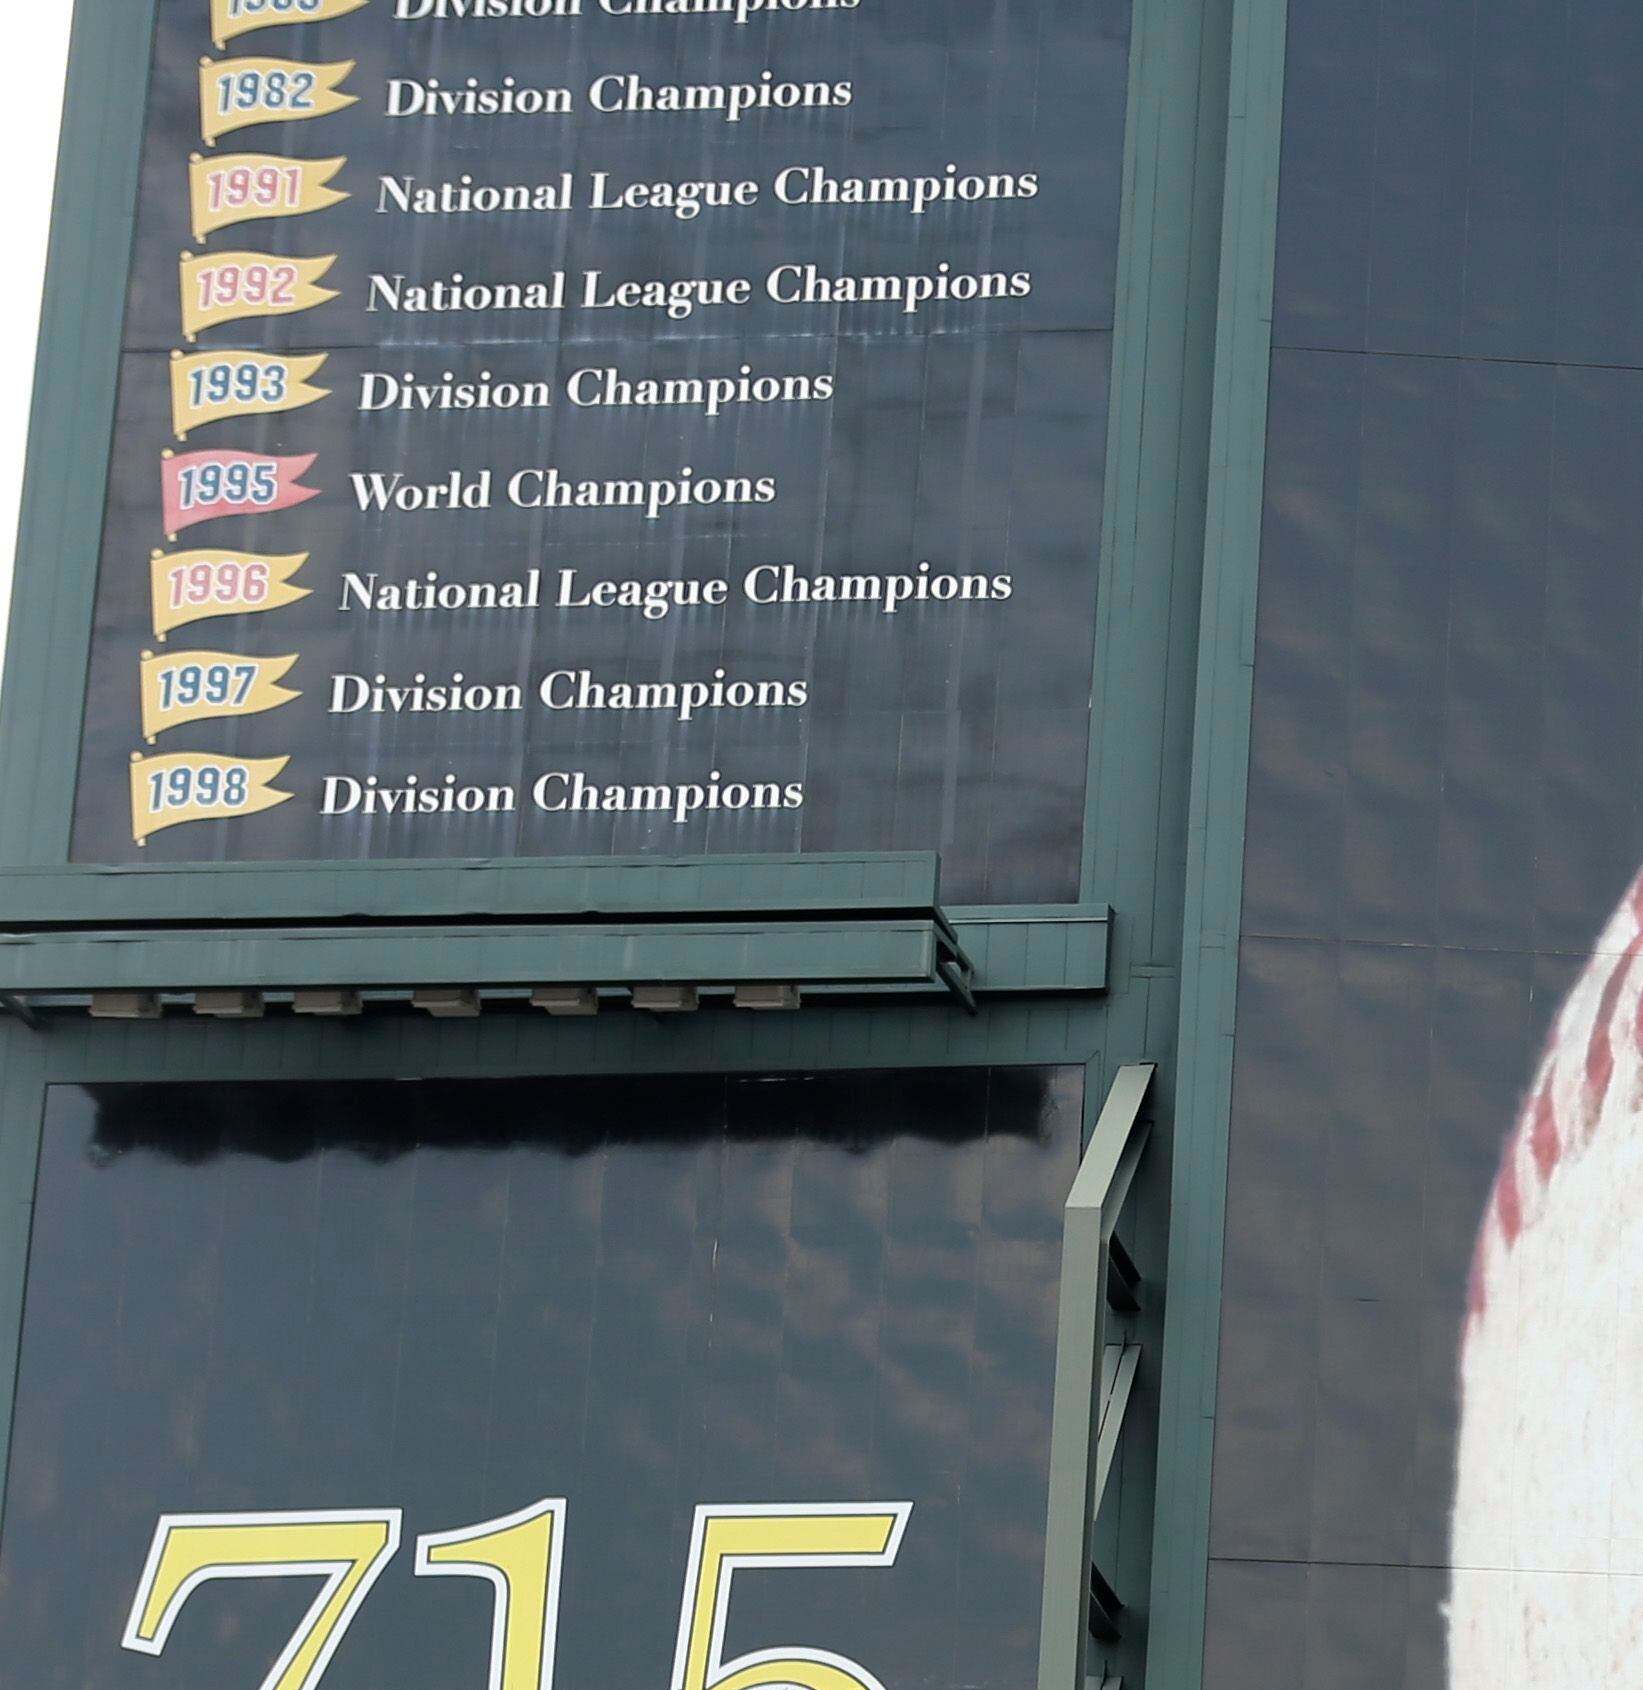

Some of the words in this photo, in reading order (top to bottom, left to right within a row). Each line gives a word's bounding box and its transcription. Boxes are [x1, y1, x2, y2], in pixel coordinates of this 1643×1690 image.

[216, 72, 315, 113] 1982
[384, 75, 573, 117] Division
[588, 70, 853, 123] Champions
[206, 166, 302, 209] 1991
[375, 171, 574, 215] National
[588, 171, 760, 221] League
[773, 163, 1039, 215] Champions
[197, 264, 297, 308] 1992
[365, 270, 566, 313] National
[579, 269, 752, 320] League
[765, 261, 1032, 314] Champions
[187, 363, 288, 407] 1993
[356, 369, 551, 411] Division
[566, 364, 834, 417] Champions
[177, 462, 277, 509] 1995
[348, 469, 492, 512] World
[507, 465, 776, 520] Champions
[168, 561, 267, 609] 1996
[337, 567, 541, 612] National
[554, 568, 729, 621] League
[743, 561, 1013, 614] Champions
[158, 662, 258, 707] 1997
[327, 671, 524, 714] Division
[539, 667, 809, 722] Champions
[147, 765, 248, 811] 1998
[318, 773, 516, 816] Division
[532, 769, 804, 824] Champions
